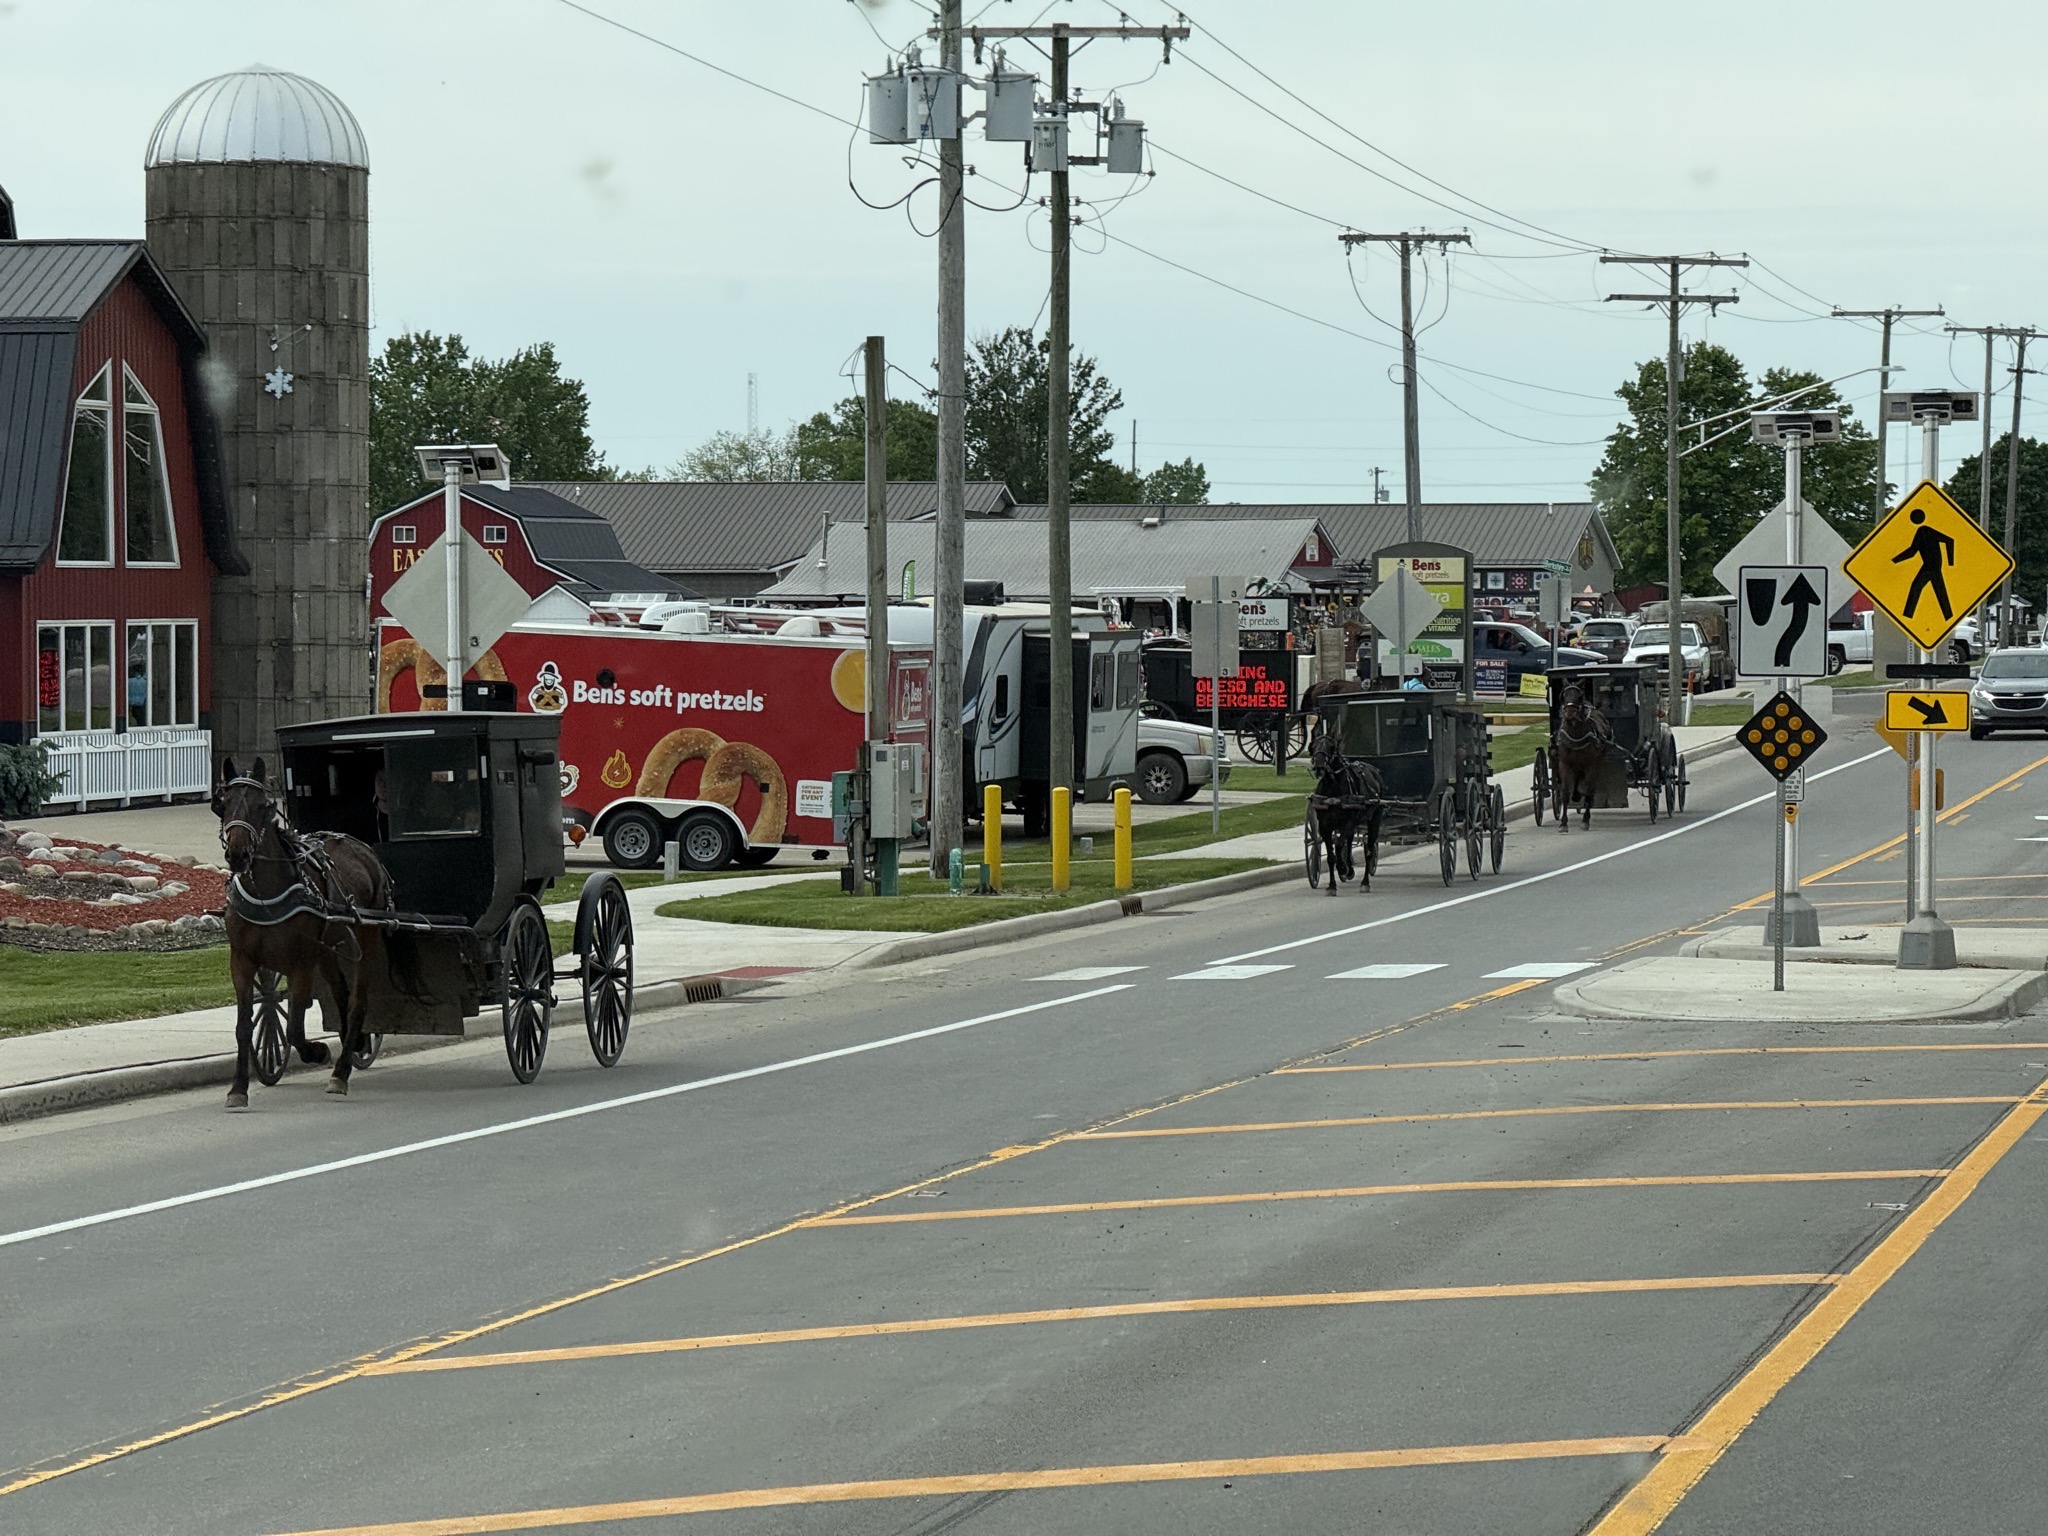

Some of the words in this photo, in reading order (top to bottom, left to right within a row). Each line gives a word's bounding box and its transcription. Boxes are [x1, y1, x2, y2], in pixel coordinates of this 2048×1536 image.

[1425, 571, 1449, 579] pretzels
[1250, 616, 1280, 627] pretzels
[470, 636, 479, 647] 3
[1430, 670, 1457, 680] ountry
[1196, 680, 1247, 693] QUESO
[1254, 680, 1286, 693] AND
[573, 680, 626, 705] Ben's
[629, 685, 673, 707] soft
[677, 690, 764, 714] pretzels
[1196, 694, 1288, 707] BEERCHESE
